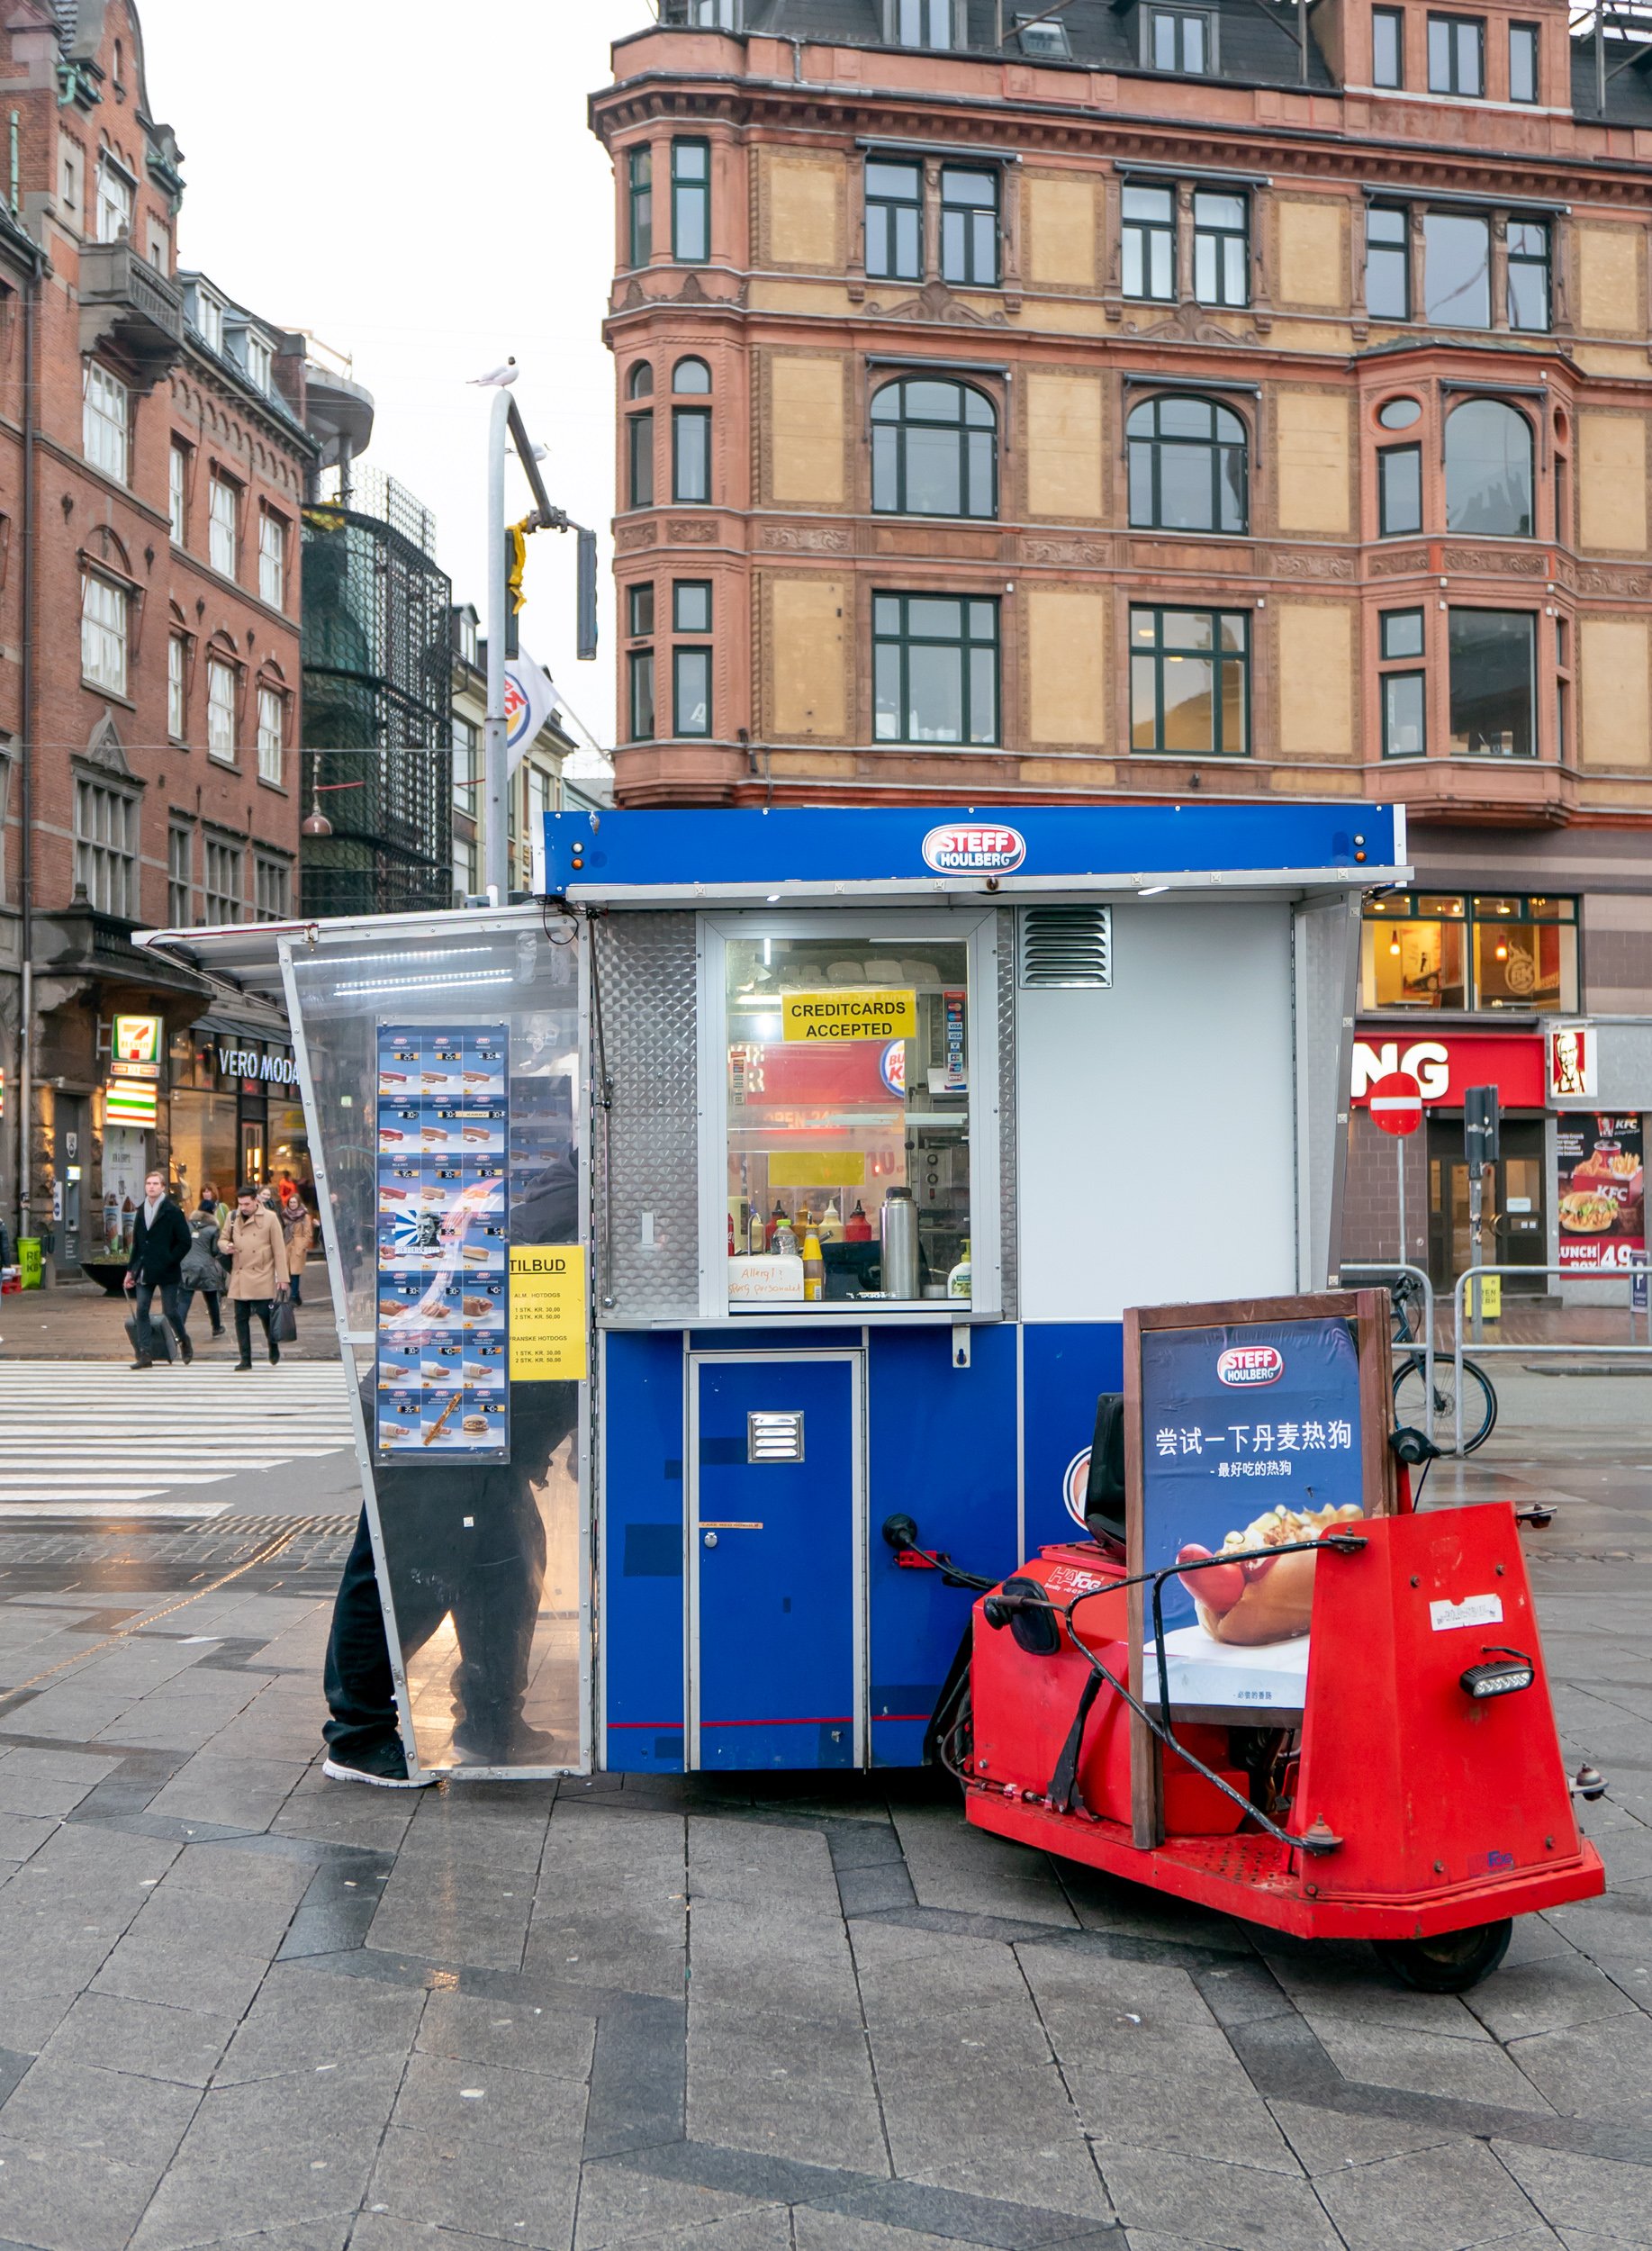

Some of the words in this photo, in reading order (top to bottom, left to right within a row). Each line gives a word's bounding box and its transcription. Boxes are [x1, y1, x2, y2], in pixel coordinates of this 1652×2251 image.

[941, 832, 1009, 852] STEFF
[941, 853, 1010, 866] HOULBERG
[791, 1002, 906, 1017] CREDITCARDS
[806, 1023, 893, 1037] ACCEPTED
[219, 1047, 257, 1079] VERO
[259, 1055, 301, 1085] MODA
[1615, 1119, 1638, 1129] KFC
[1596, 1184, 1629, 1202] KFC
[1559, 1245, 1597, 1259] UNCH
[510, 1259, 566, 1271] TILBUD
[1226, 1351, 1273, 1369] STEFF
[1227, 1368, 1275, 1382] HOULBERG
[1156, 1420, 1352, 1457] 尝试一下丹麦热狗
[1218, 1460, 1292, 1478] 最好吃的热狗
